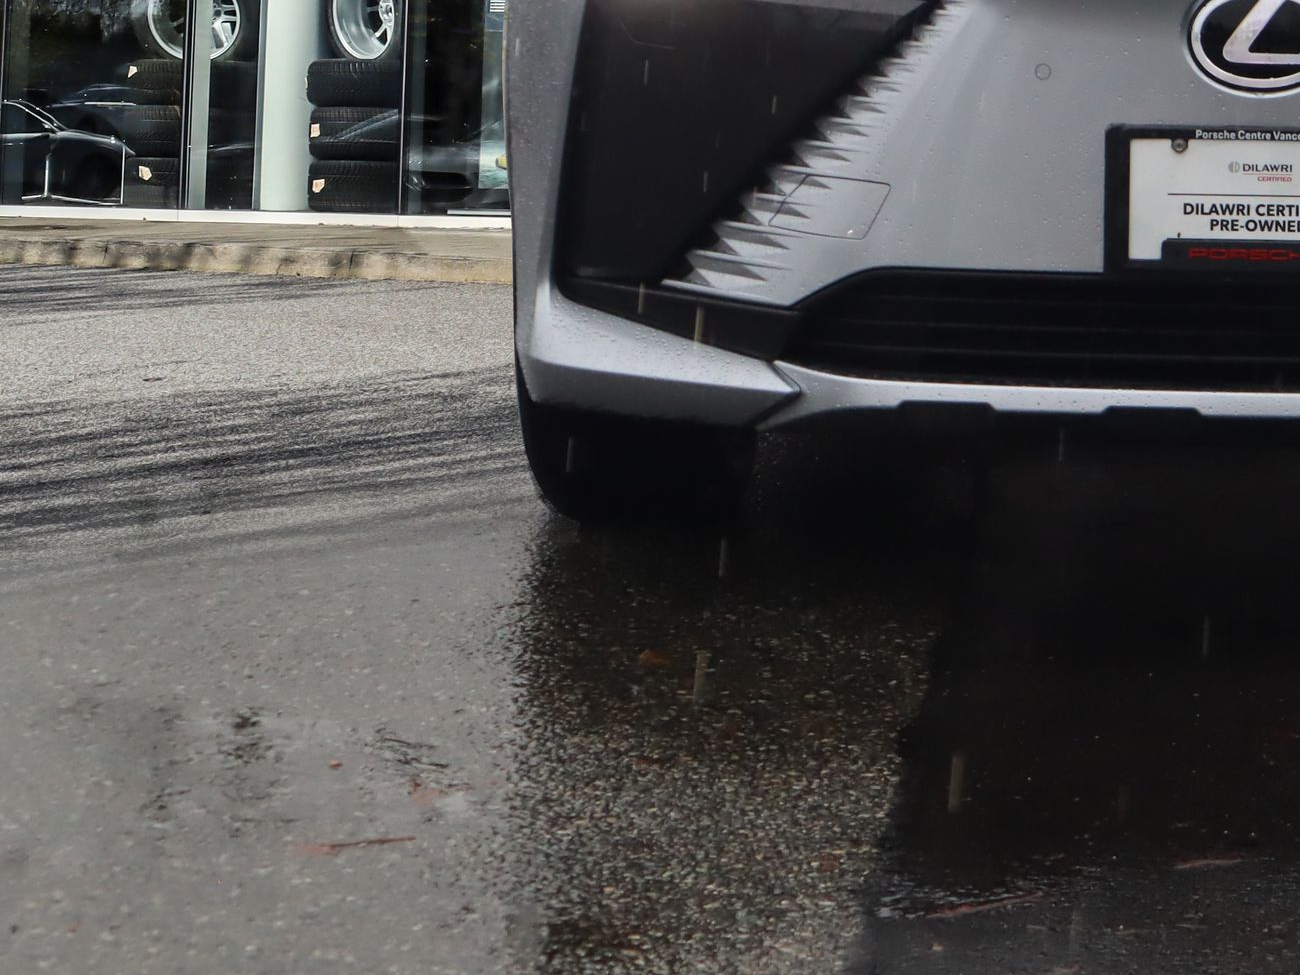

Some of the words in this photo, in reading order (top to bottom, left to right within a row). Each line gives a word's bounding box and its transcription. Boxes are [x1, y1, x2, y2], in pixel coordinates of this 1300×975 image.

[1195, 129, 1236, 140] Porsche
[1238, 130, 1271, 140] Centre
[1242, 163, 1293, 173] DILAWRI
[1183, 203, 1250, 216] DILAWRI
